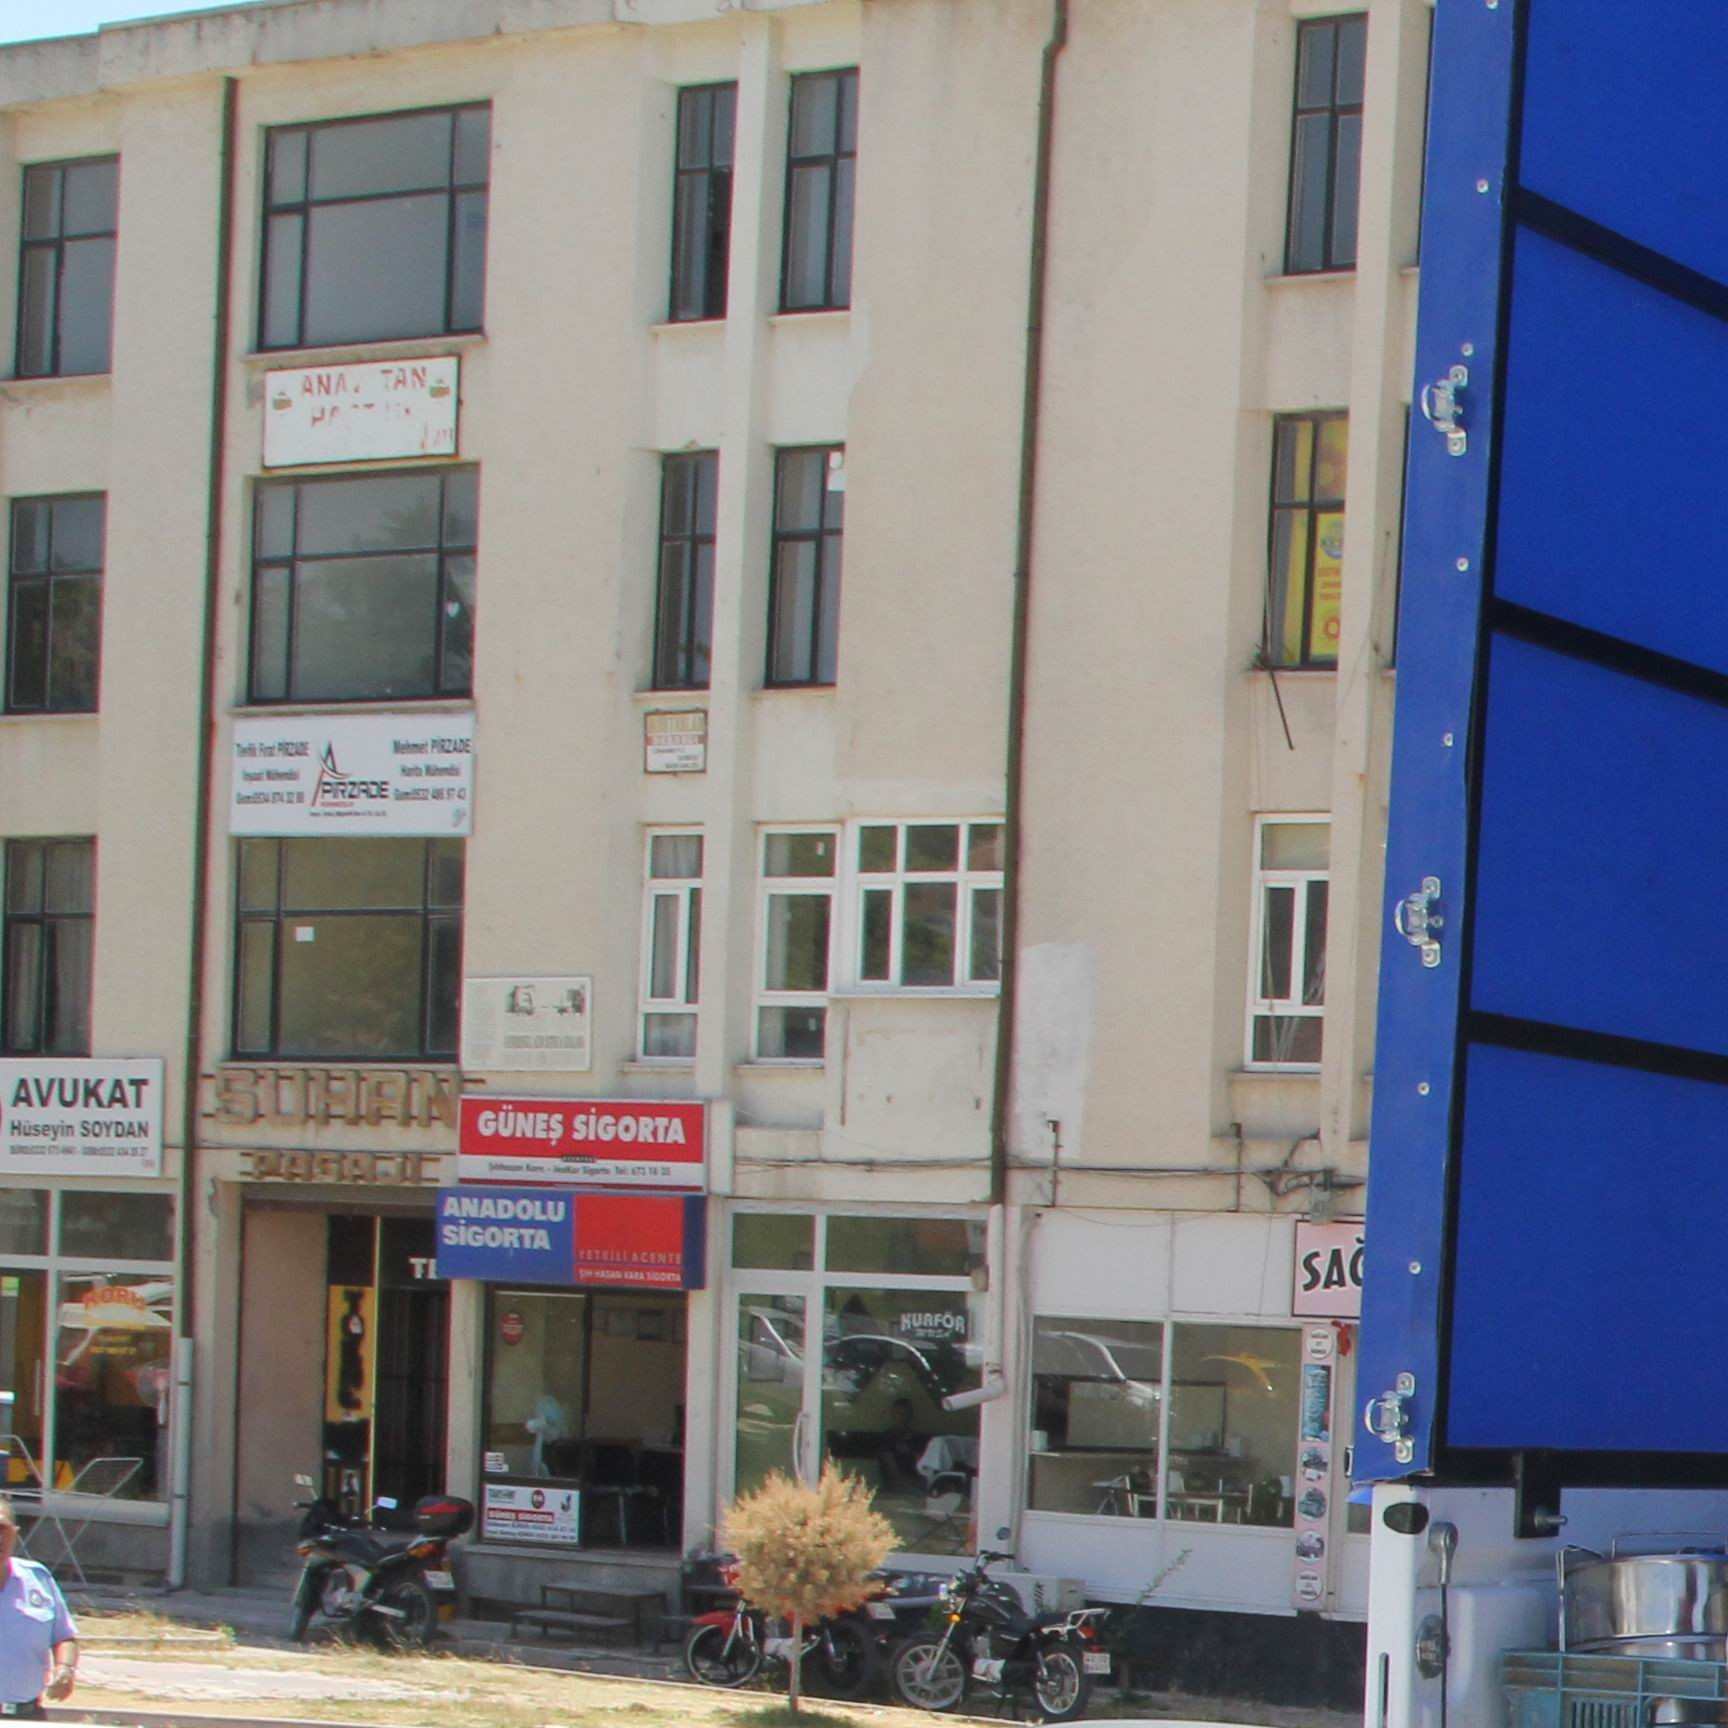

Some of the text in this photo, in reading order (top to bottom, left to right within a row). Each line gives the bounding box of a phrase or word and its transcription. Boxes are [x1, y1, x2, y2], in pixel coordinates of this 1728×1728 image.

[11, 1077, 149, 1109] AVUKAT
[10, 1119, 149, 1141] Hüseyin SOYDAN
[477, 1105, 687, 1146] GÜNEŞ SİGORTA
[443, 1197, 566, 1223] ANADOLU
[443, 1219, 551, 1250] SİGORTA
